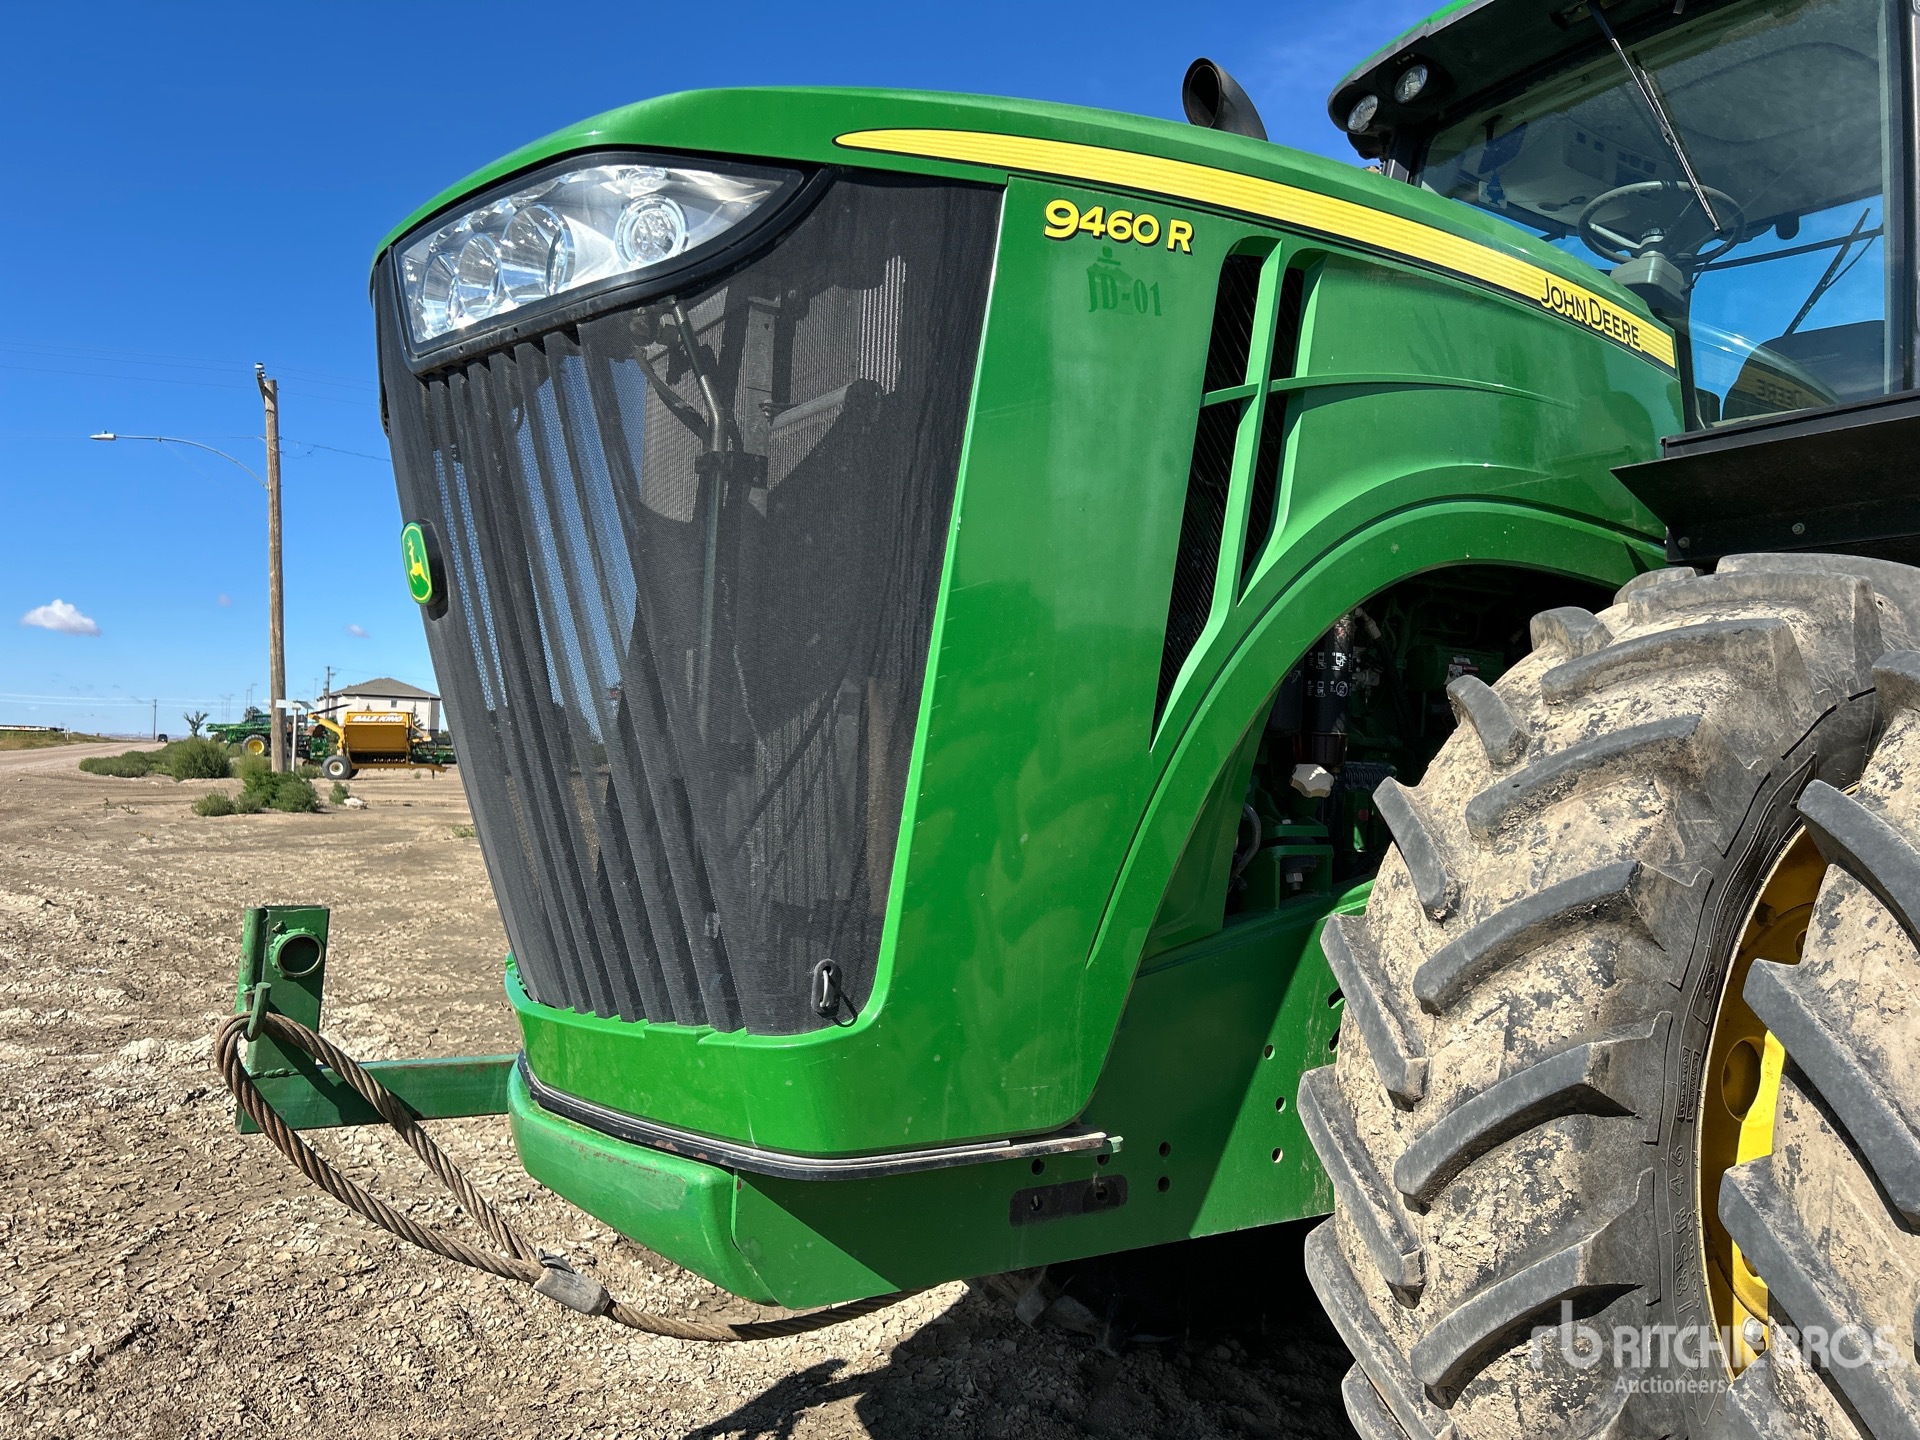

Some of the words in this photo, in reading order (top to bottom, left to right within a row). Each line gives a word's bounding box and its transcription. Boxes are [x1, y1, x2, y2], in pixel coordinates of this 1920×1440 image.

[1044, 199, 1162, 246] 9460
[1167, 218, 1193, 255] R
[1541, 277, 1588, 324] JOHN
[1588, 297, 1642, 352] DEERE
